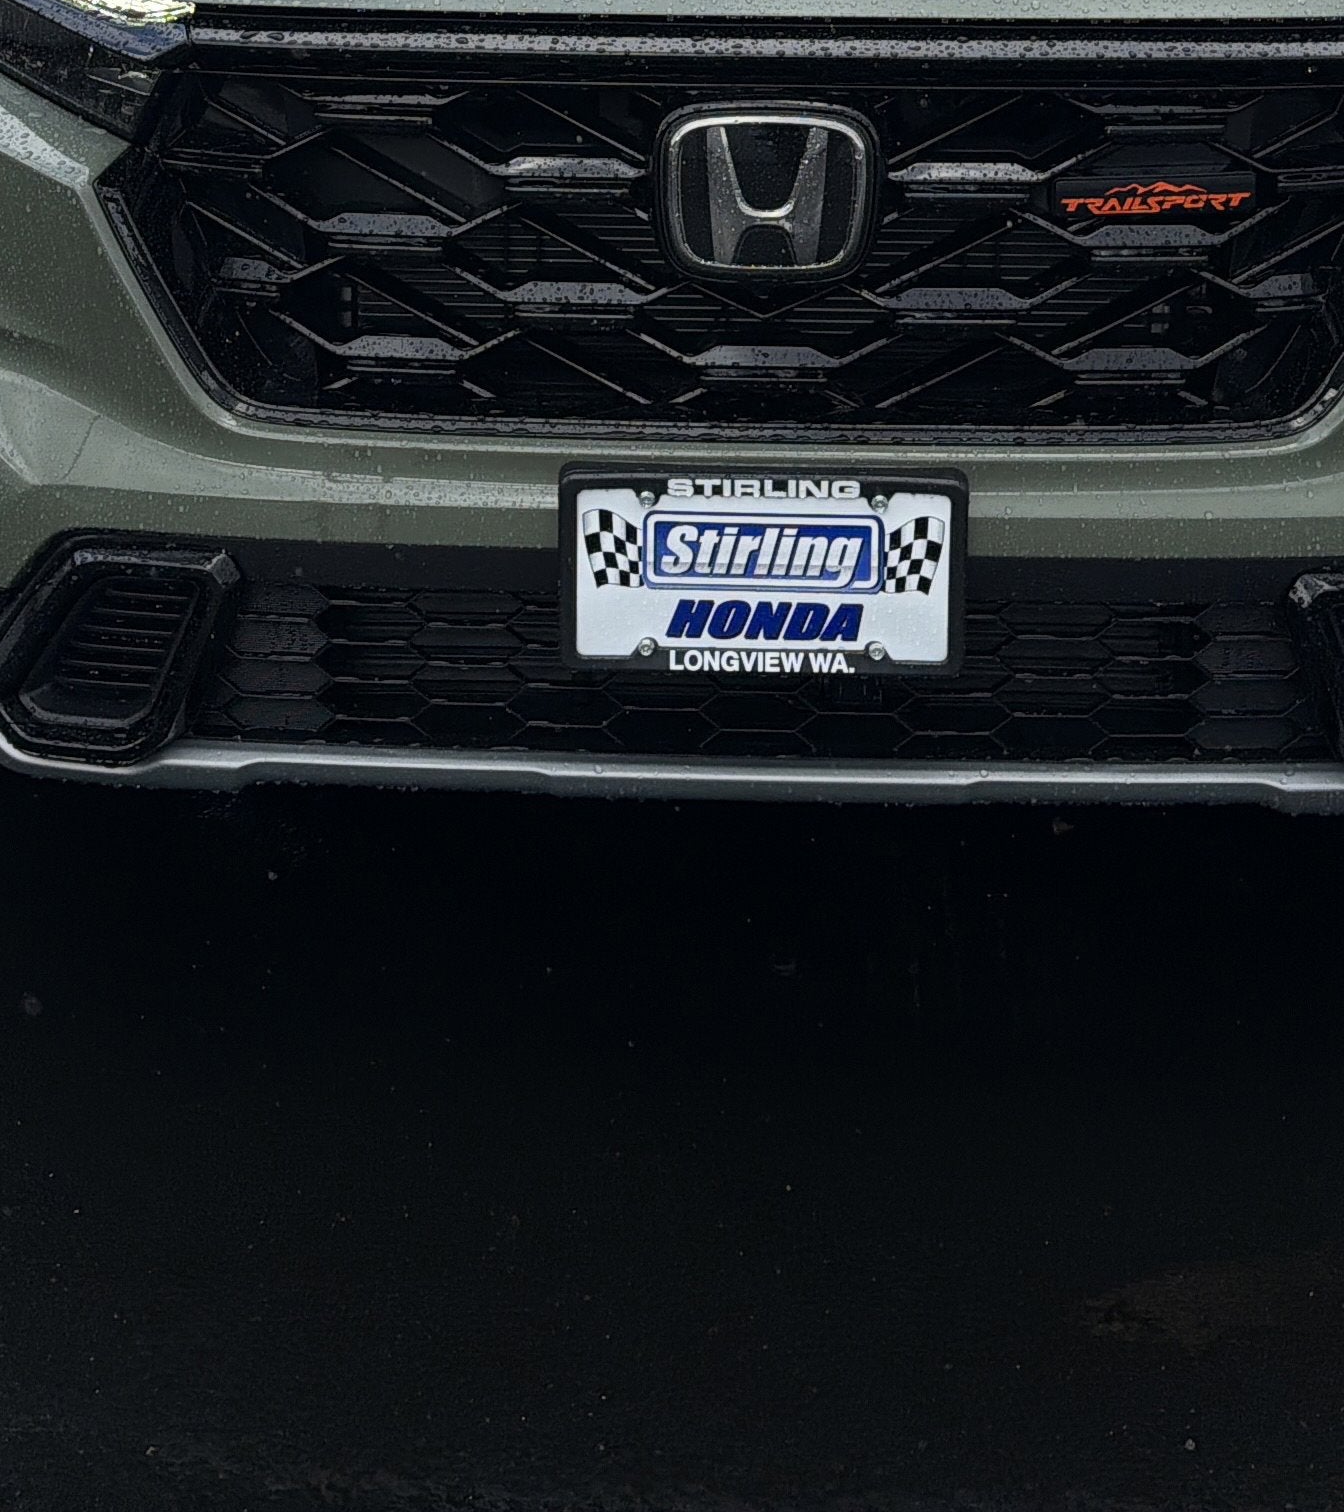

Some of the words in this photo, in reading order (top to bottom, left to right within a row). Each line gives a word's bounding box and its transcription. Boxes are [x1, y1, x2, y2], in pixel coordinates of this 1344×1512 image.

[1061, 192, 1251, 215] TRAILSPORT
[666, 479, 860, 499] STIRLING
[660, 524, 863, 586] Stirling
[666, 599, 864, 641] HONDA
[669, 650, 804, 673] LONGVIEW
[809, 653, 856, 674] WA.
